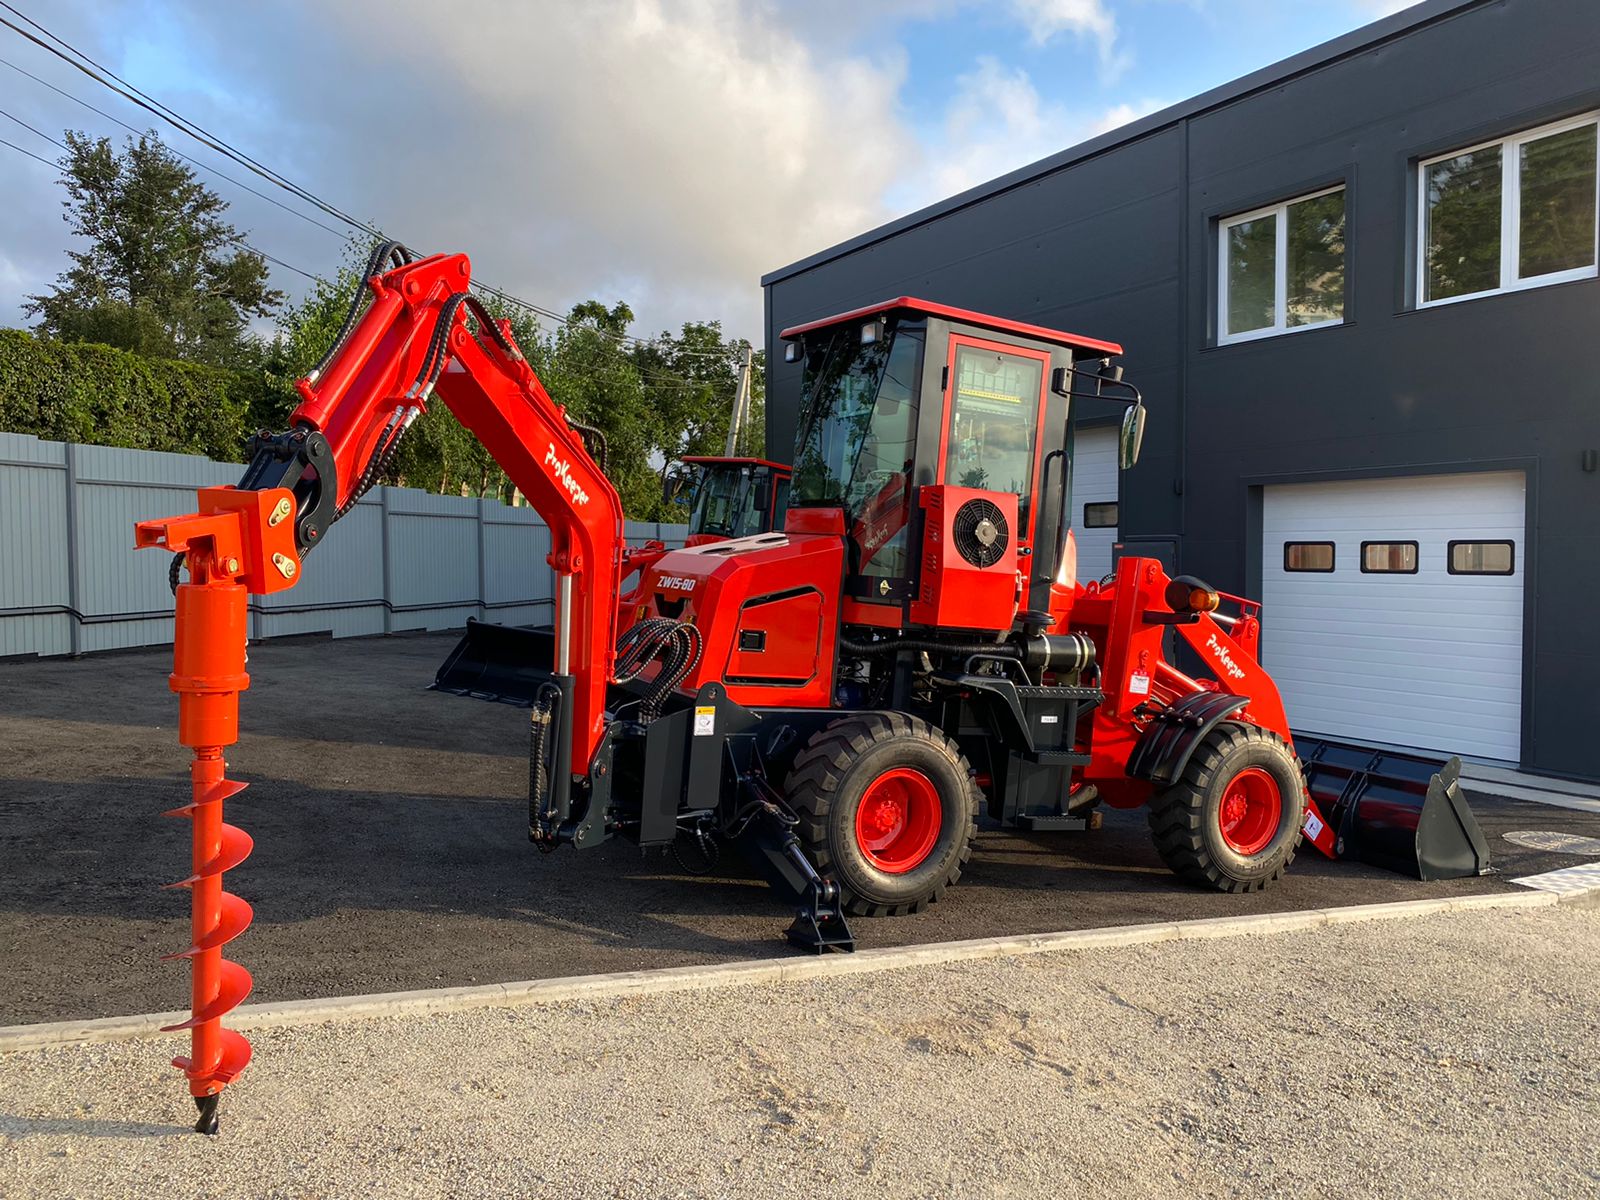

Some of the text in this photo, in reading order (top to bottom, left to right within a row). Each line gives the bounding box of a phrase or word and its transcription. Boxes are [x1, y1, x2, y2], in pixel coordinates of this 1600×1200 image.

[544, 442, 589, 506] ProKeeper
[656, 575, 696, 591] ZW15-80
[1206, 633, 1246, 678] ProKeeper
